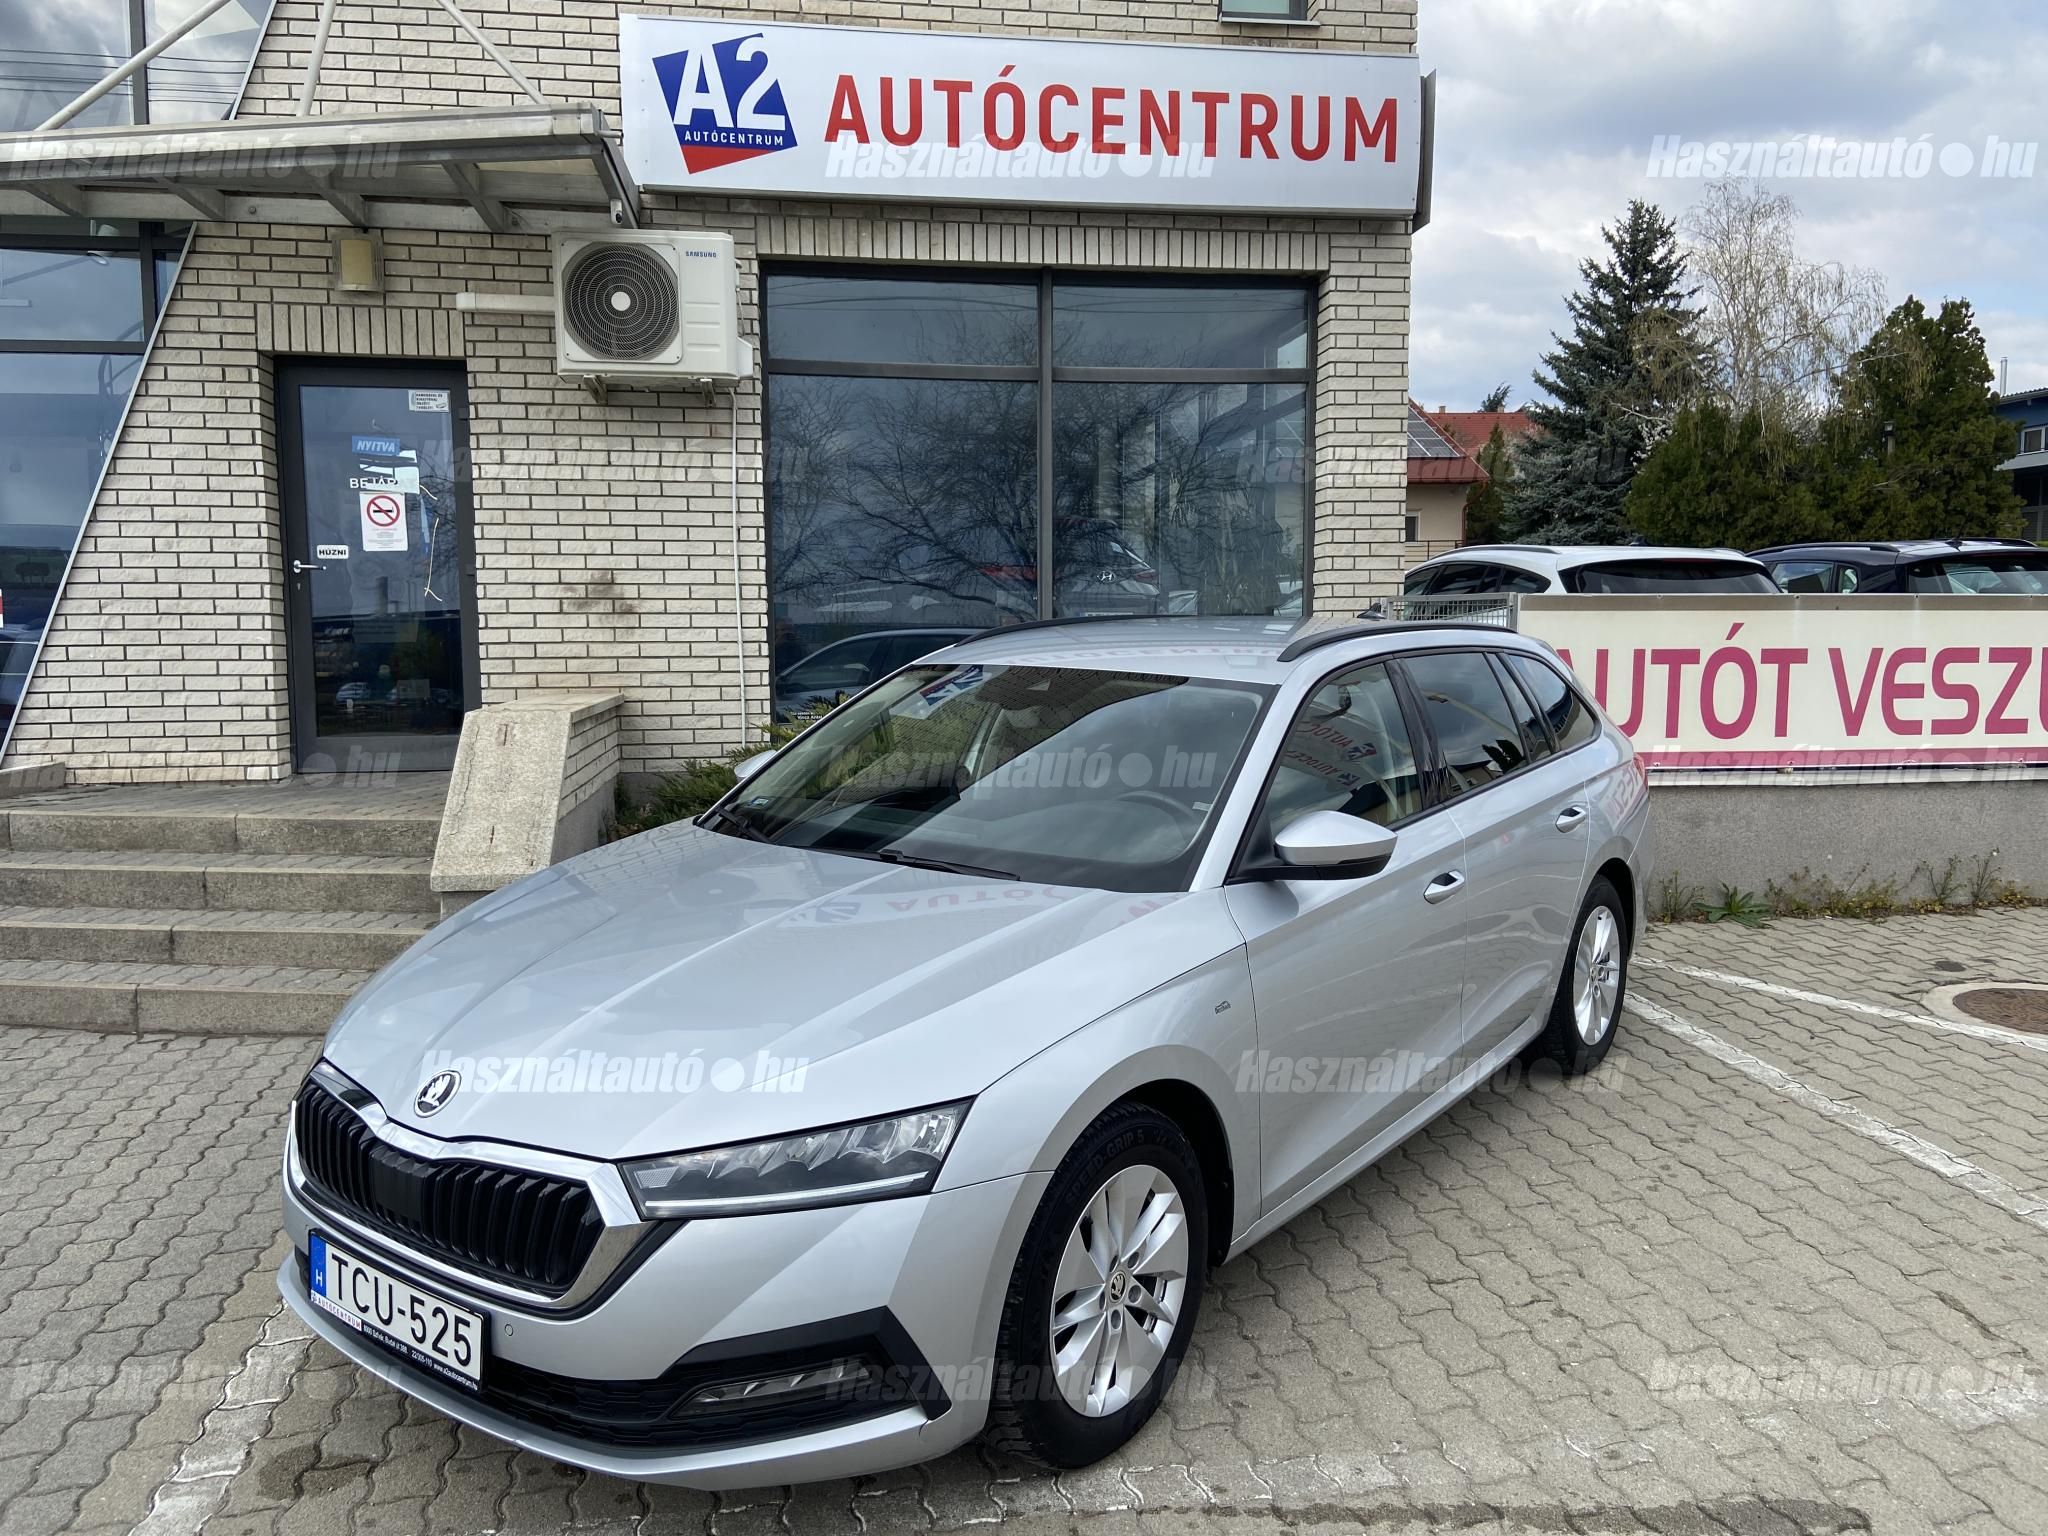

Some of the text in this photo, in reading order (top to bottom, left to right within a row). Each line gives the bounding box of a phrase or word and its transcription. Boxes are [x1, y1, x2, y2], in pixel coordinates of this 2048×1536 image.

[673, 37, 786, 131] A2
[684, 130, 784, 146] AUTÓCENTRUM
[824, 64, 1398, 163] AUTÓCENTRUM
[685, 250, 717, 258] SAMSUNG
[356, 440, 396, 453] NYITVA
[1827, 646, 2048, 737] VESZ
[315, 1268, 323, 1288] H
[331, 1252, 472, 1367] TCU-525
